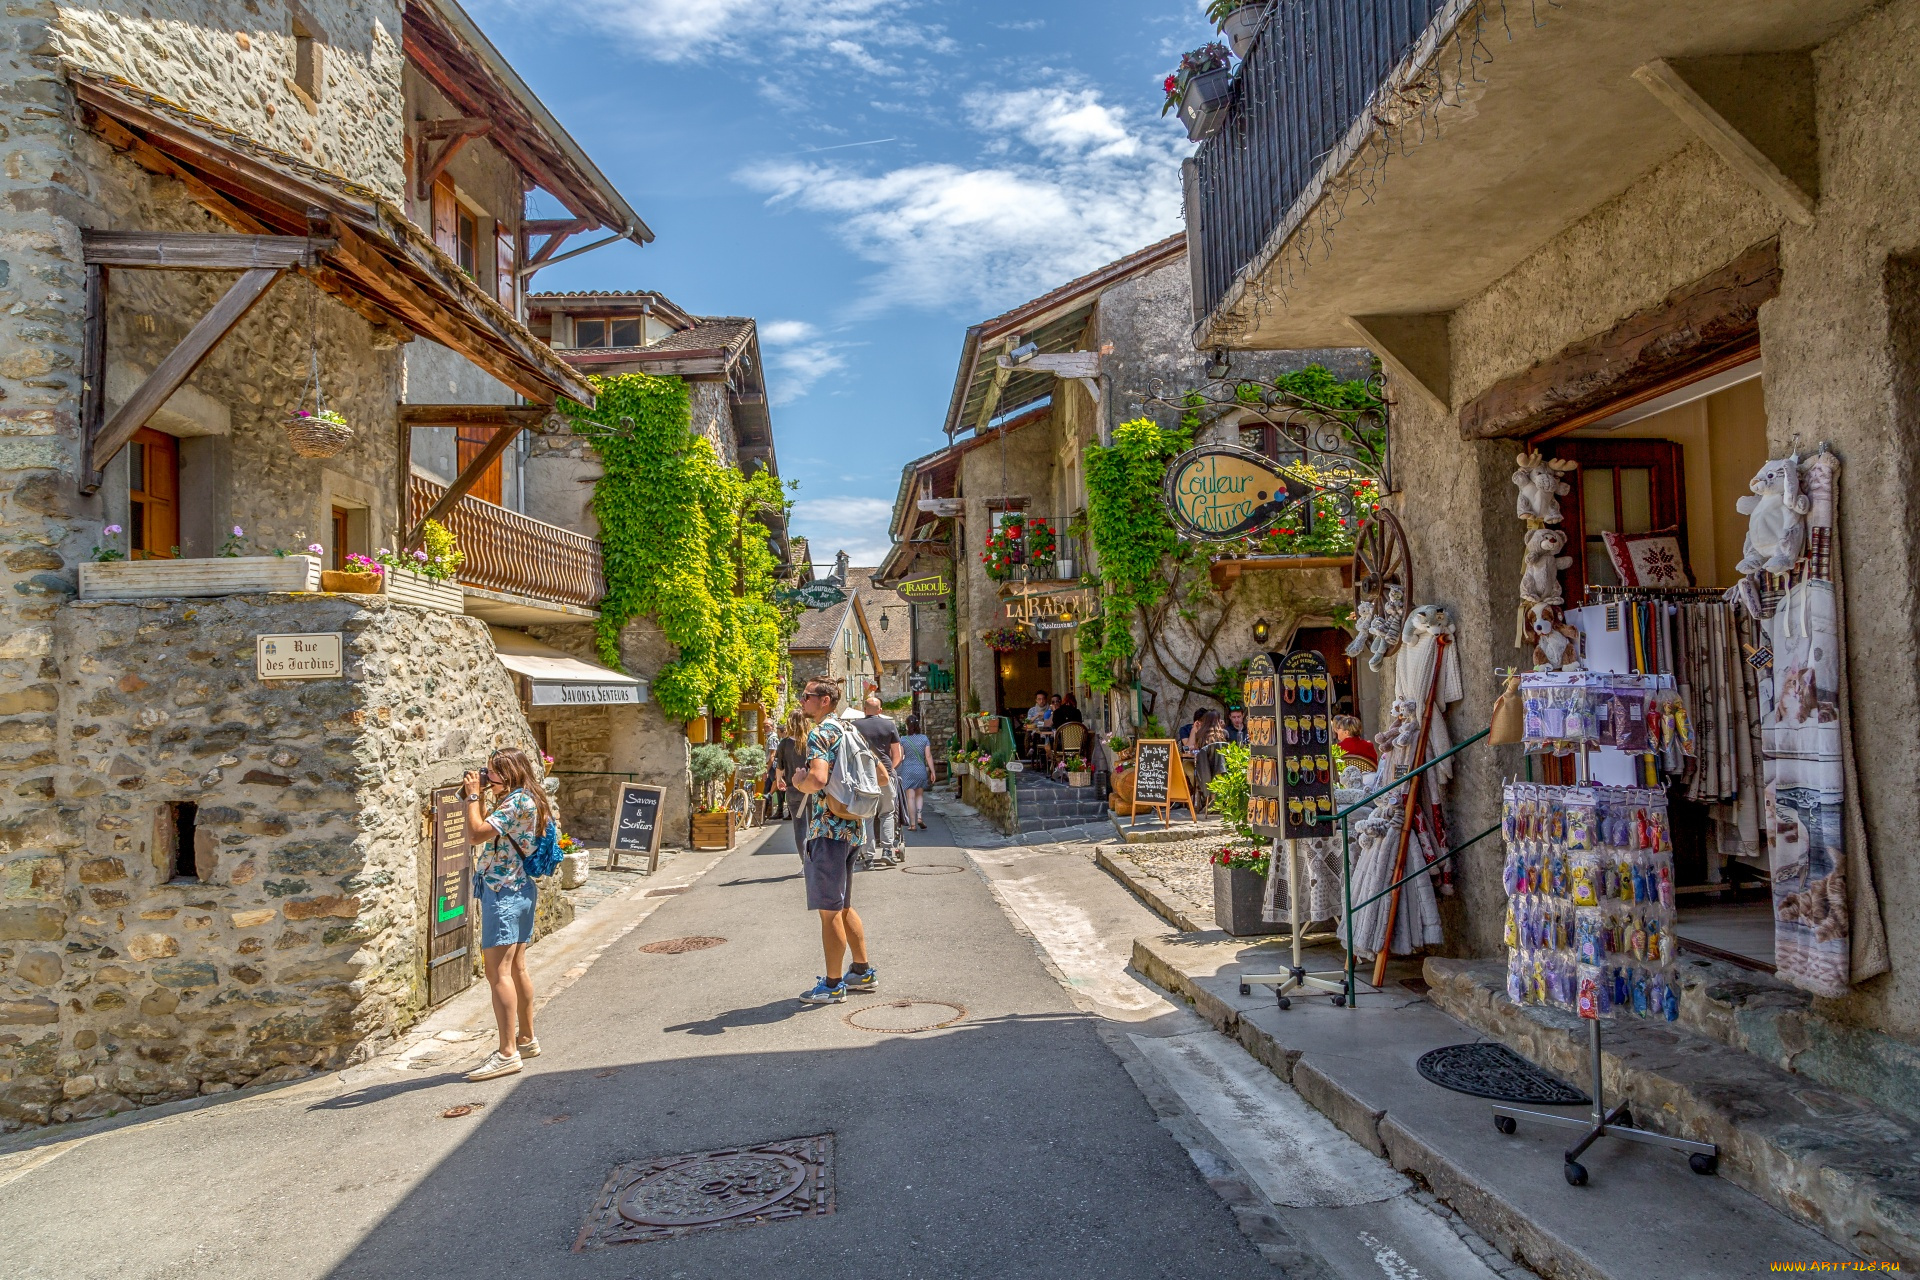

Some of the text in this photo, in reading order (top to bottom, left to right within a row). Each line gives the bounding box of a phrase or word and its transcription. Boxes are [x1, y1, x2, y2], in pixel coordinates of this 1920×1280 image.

[1178, 456, 1254, 495] Couleur
[1178, 494, 1256, 532] Nature
[898, 576, 951, 596] TRABOULE
[1005, 603, 1024, 618] LA
[294, 639, 318, 652] Rue
[266, 657, 335, 671] des Jardins
[591, 690, 596, 702] &
[625, 793, 657, 805] Savons
[620, 818, 653, 831] Senteurs
